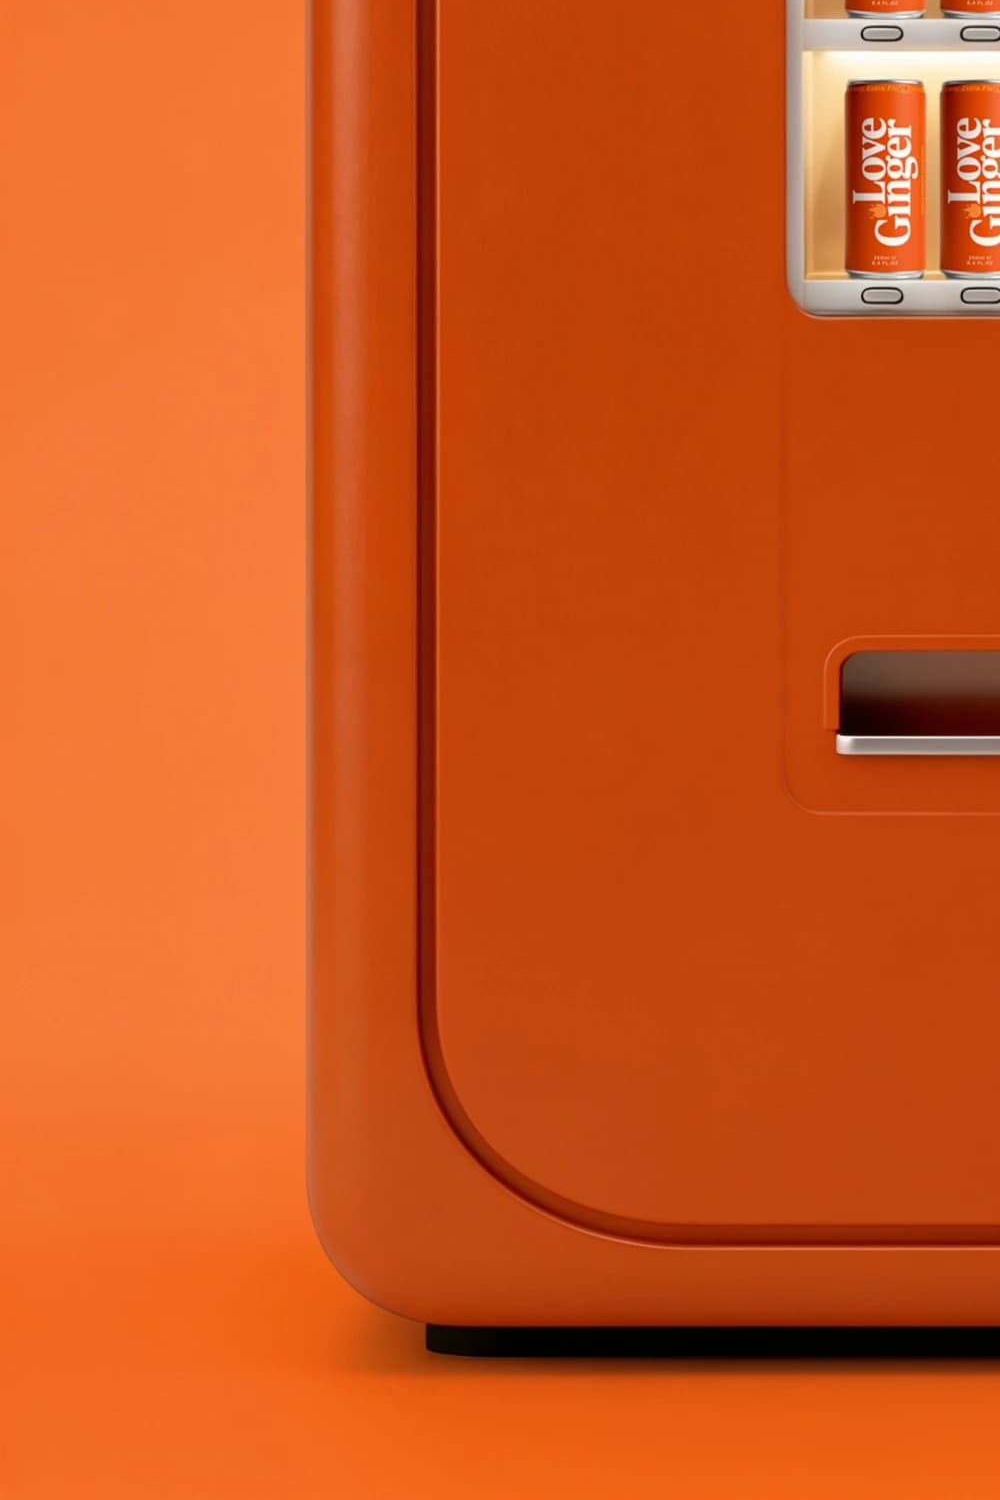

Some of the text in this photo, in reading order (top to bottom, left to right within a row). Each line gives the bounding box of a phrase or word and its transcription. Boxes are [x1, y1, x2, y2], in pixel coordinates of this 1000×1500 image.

[853, 117, 887, 204] Love
[874, 118, 919, 247] Ginger
[948, 117, 982, 204] Love
